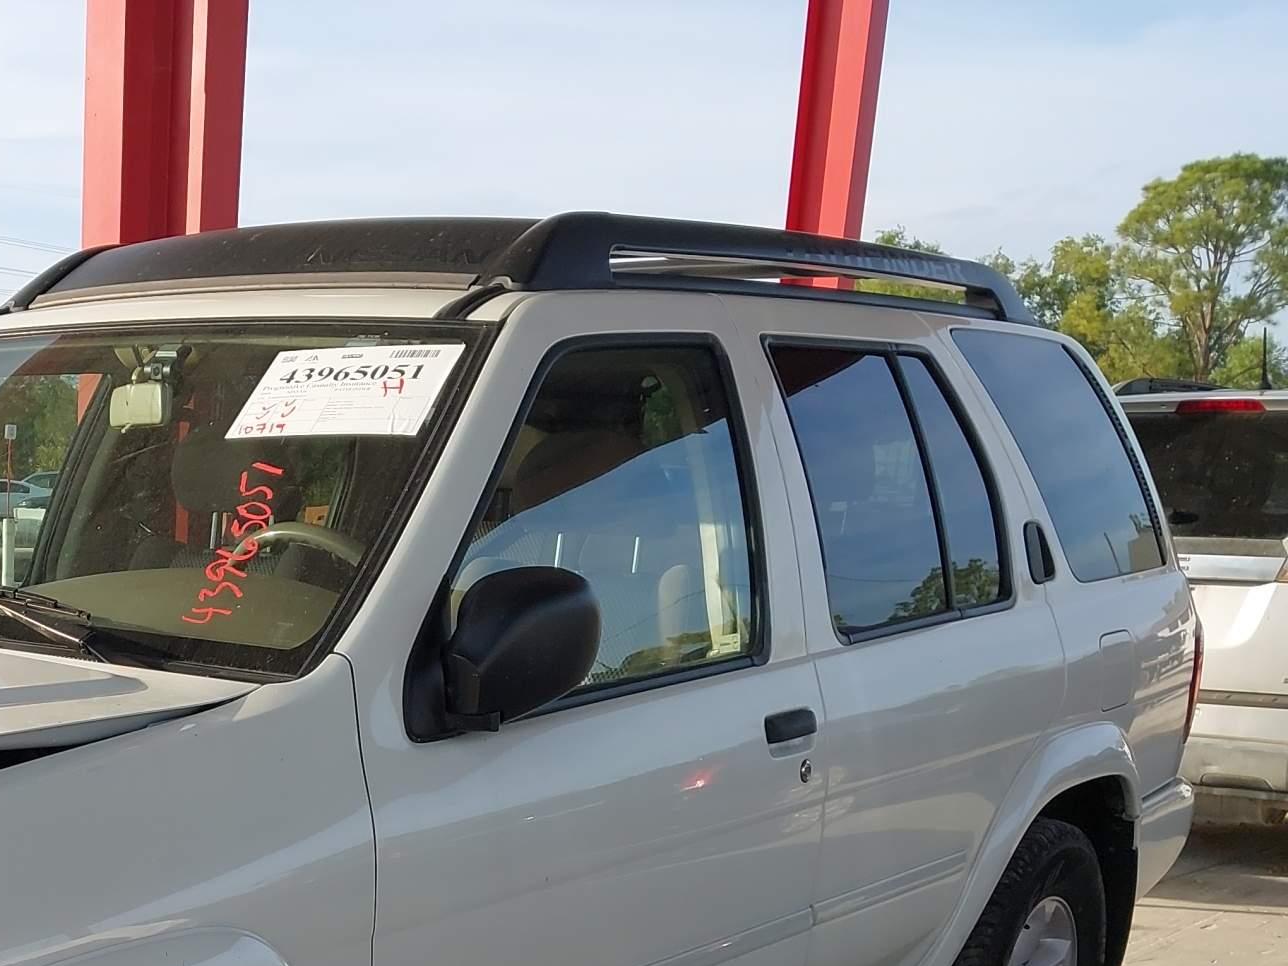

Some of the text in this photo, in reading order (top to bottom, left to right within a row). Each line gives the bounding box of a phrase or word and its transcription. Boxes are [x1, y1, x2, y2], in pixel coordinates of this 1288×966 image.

[279, 363, 424, 384] 43965051
[381, 378, 406, 398] H
[182, 462, 286, 624] 43965051
